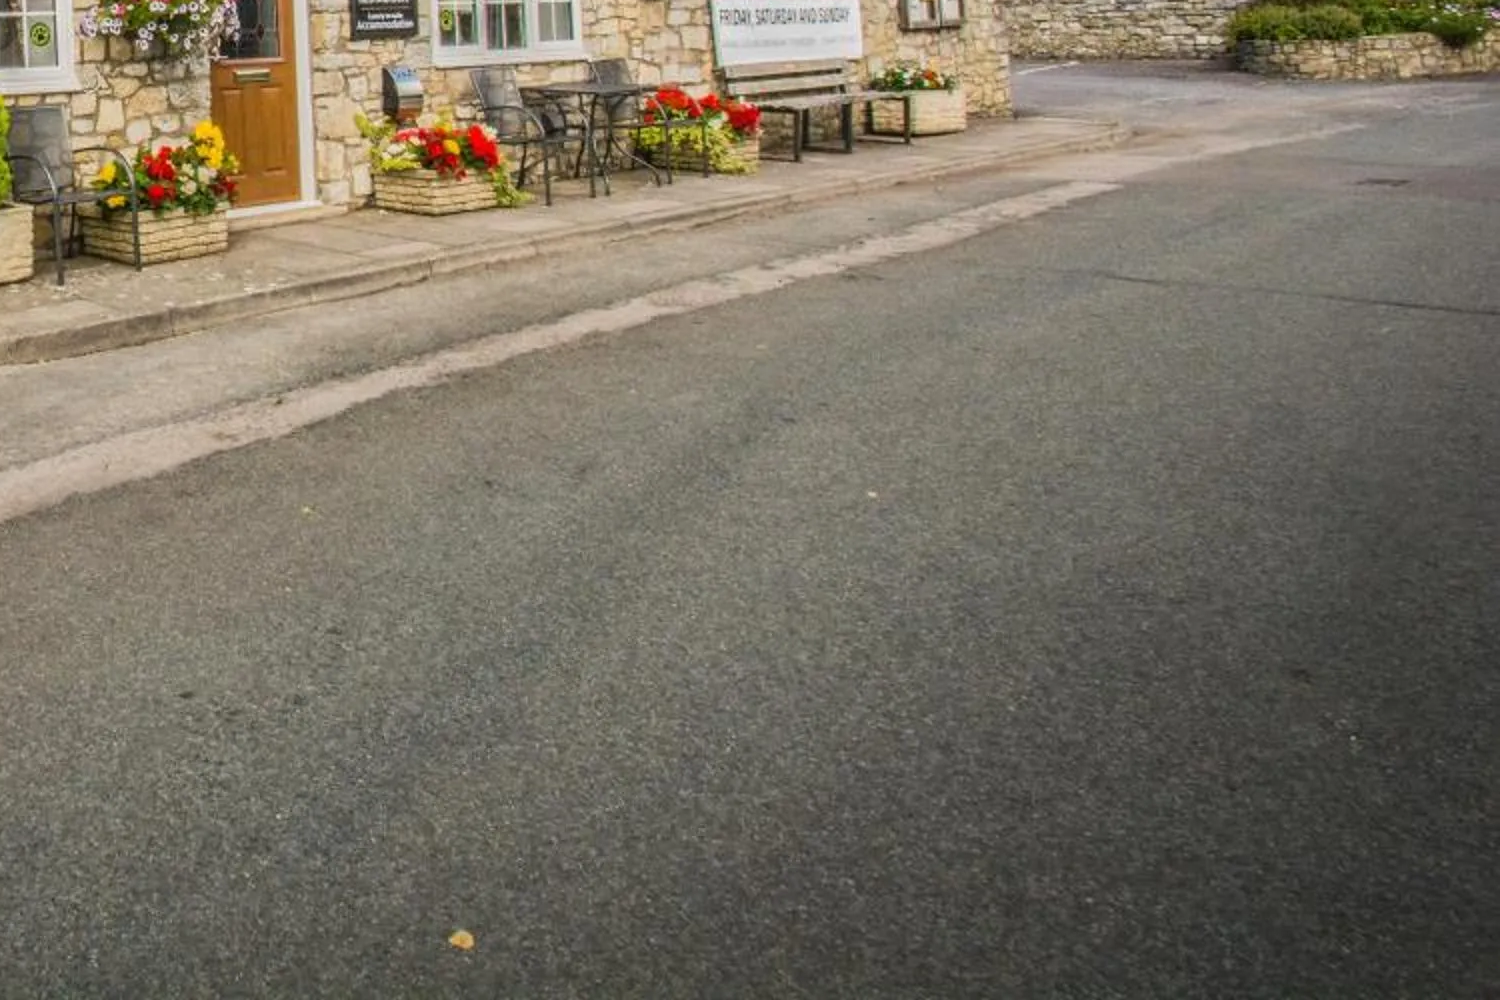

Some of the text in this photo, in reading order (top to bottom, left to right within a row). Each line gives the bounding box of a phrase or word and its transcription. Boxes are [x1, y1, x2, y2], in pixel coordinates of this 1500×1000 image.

[755, 8, 797, 25] SATURDAY
[799, 8, 817, 23] AND
[819, 7, 851, 23] SUNDAY
